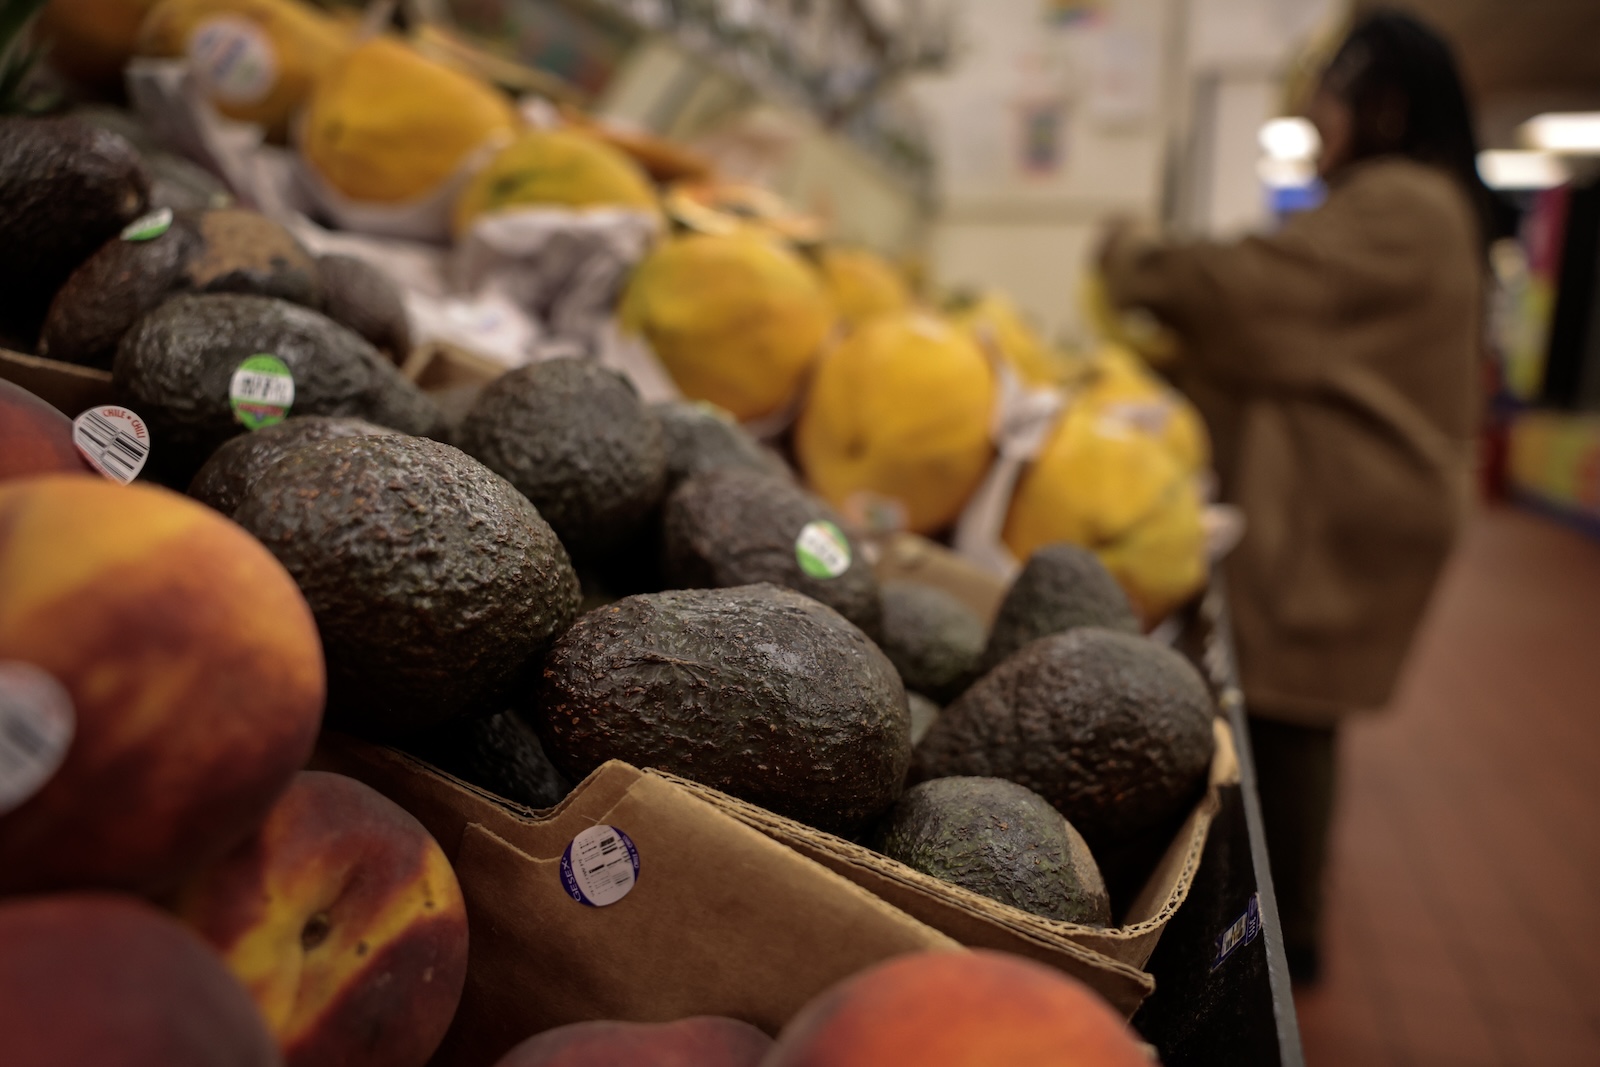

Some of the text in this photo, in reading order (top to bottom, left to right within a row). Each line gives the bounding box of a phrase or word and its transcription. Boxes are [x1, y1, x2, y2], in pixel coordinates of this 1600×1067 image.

[102, 408, 146, 439] CHILE CHILI
[562, 859, 581, 902] GESEX
